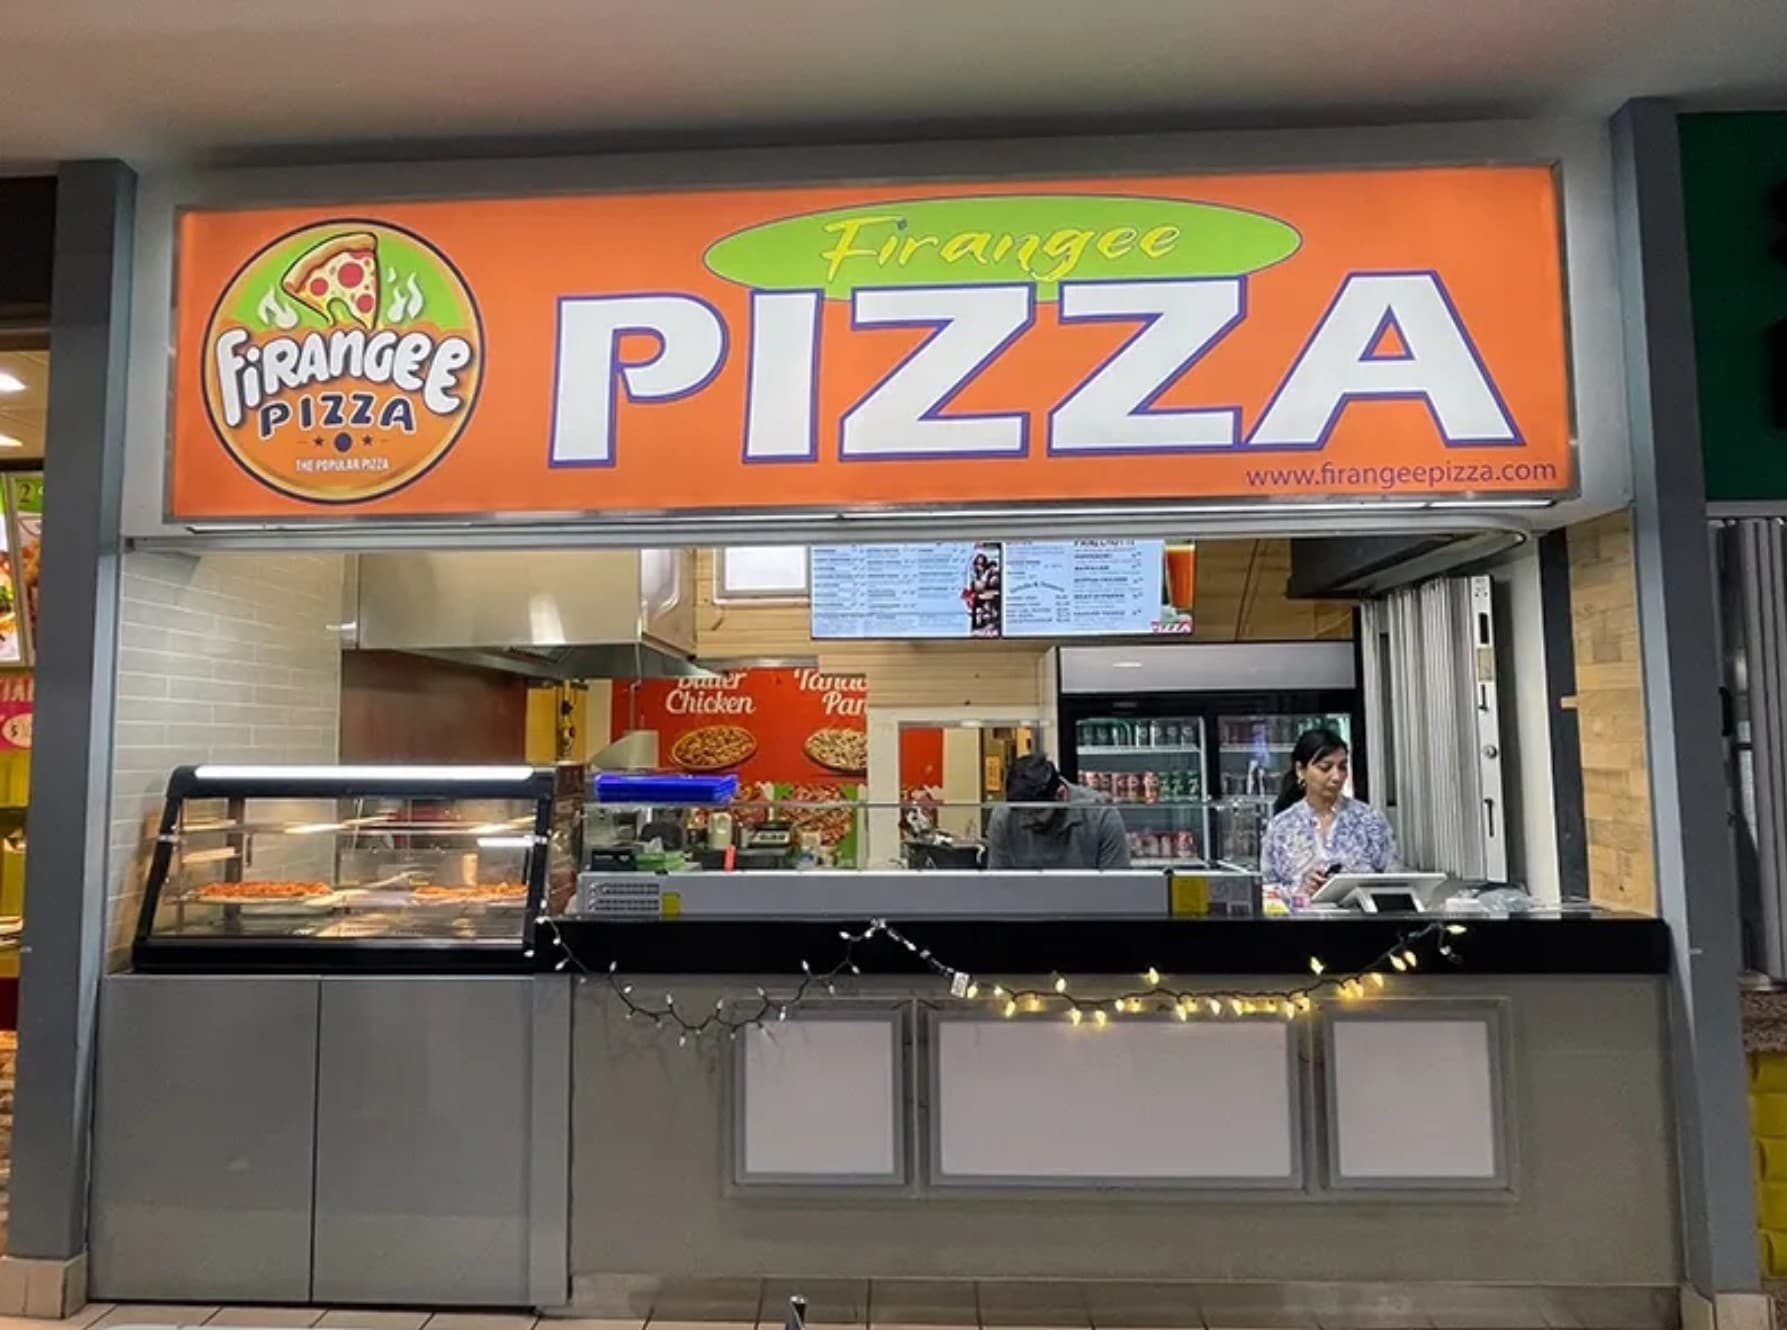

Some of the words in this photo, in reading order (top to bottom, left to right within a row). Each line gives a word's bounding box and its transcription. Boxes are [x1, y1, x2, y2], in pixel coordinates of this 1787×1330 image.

[821, 214, 1181, 283] Firangee
[547, 271, 1527, 468] PIZZA
[258, 393, 416, 438] PIZZA
[296, 458, 313, 472] THE
[316, 457, 360, 472] POPULAR
[362, 455, 390, 471] PIZZA
[1246, 459, 1557, 488] www.firangeepizza.com
[665, 688, 758, 714] Chicken
[822, 690, 869, 715] Pan
